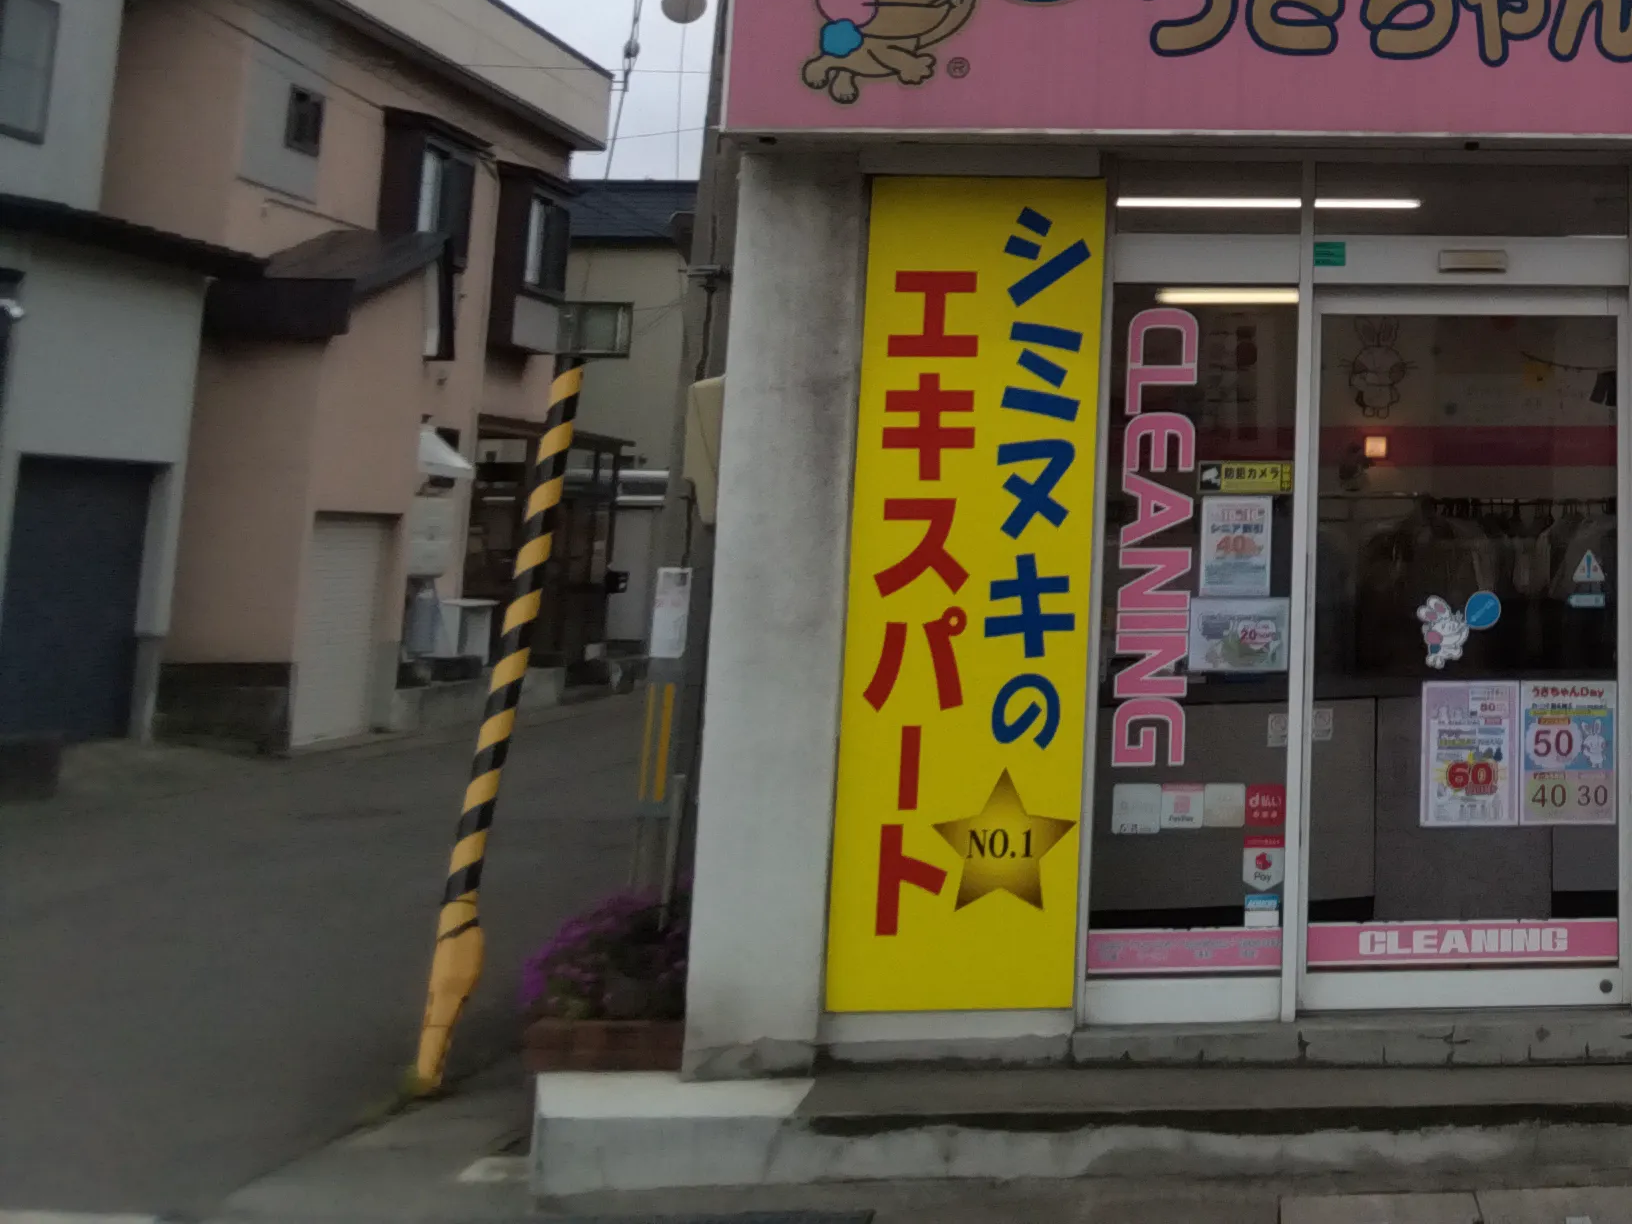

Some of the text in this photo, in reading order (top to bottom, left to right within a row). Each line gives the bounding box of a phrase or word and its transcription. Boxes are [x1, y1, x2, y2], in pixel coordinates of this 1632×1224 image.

[984, 205, 1092, 750] シミヌキの
[1111, 307, 1199, 767] CLEANING
[862, 270, 979, 937] エキスパート
[1533, 729, 1574, 757] 50
[1531, 784, 1608, 808] 40 30
[966, 827, 1035, 861] NO.1
[1358, 927, 1568, 955] CLEANING
